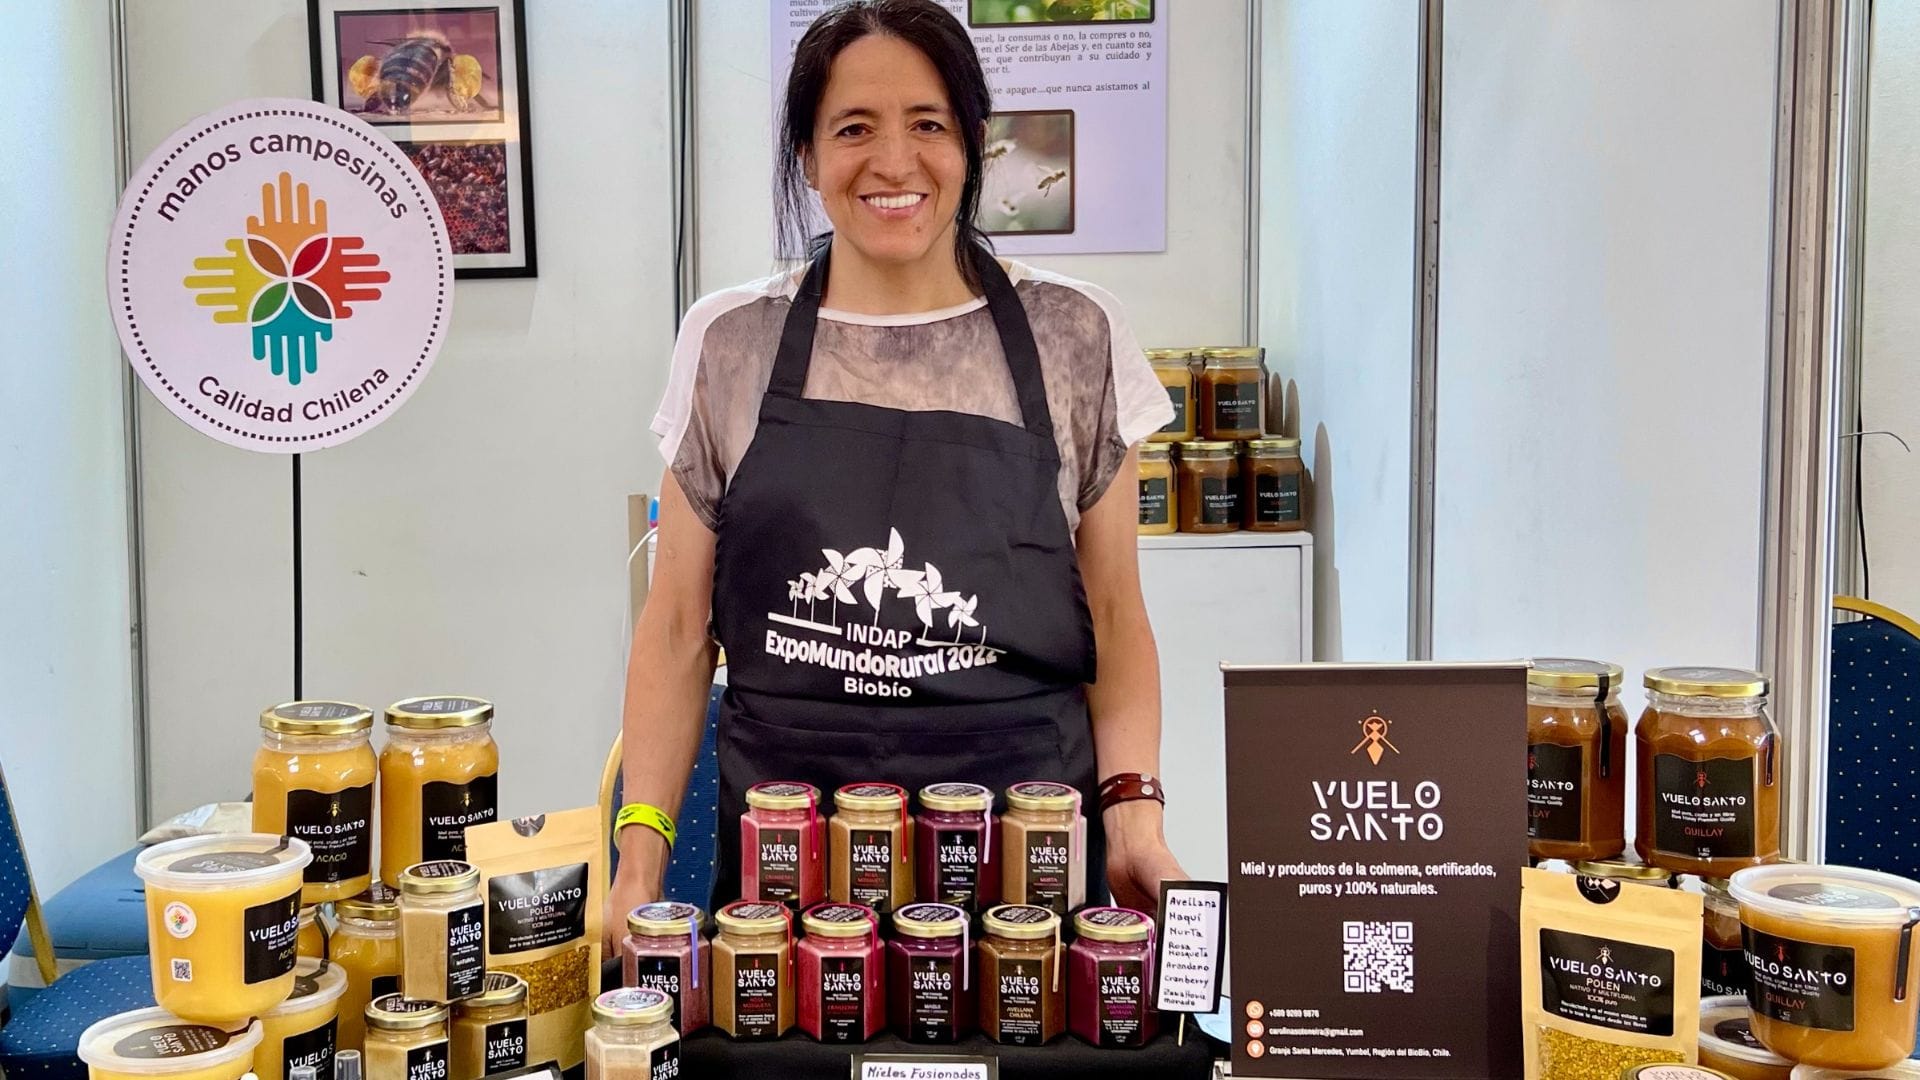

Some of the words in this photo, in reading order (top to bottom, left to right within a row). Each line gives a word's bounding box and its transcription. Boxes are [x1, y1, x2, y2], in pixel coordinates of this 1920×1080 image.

[997, 33, 1005, 42] la
[1079, 32, 1087, 40] la
[1090, 32, 1127, 42] compres
[1005, 44, 1019, 52] Ser
[1022, 44, 1032, 52] de
[1036, 43, 1047, 51] las
[1050, 43, 1079, 53] Abejas
[1105, 42, 1134, 50] cuanto
[1137, 41, 1151, 49] sea
[996, 56, 1013, 65] que
[1019, 53, 1071, 64] contribuyan
[1089, 53, 1099, 61] su
[1106, 51, 1140, 60] cuidado
[1066, 84, 1092, 92] nunca
[1096, 82, 1138, 91] asistamos
[1142, 81, 1150, 90] al
[157, 142, 242, 223] manos
[249, 134, 408, 219] campesinas
[198, 375, 293, 422] Calidad
[302, 368, 389, 421] Chilena
[847, 622, 912, 649] INDAP
[765, 629, 945, 679] ExpoMundoRural
[949, 645, 997, 672] 2022
[844, 677, 912, 698] Biobío
[1531, 779, 1574, 791] SANTO
[1312, 780, 1441, 809] VUELO
[1662, 792, 1700, 806] VUELO
[1703, 795, 1746, 806] SANTO
[429, 815, 466, 826] VUELO
[467, 807, 494, 823] SANTO
[294, 825, 333, 834] VUELO
[334, 819, 366, 834] SANTO
[1310, 813, 1444, 841] SANTO
[1684, 826, 1724, 837] QUILLAY
[762, 844, 797, 853] VUELO
[853, 844, 889, 854] VUELO
[941, 845, 976, 855] VUELO
[1030, 846, 1067, 856] VUELO
[315, 852, 348, 863] ACACIO
[761, 852, 797, 862] SANTO
[853, 853, 890, 863] SANTO
[940, 853, 977, 863] SANTO
[1030, 855, 1067, 864] SANTO
[1241, 861, 1265, 875] Miel
[1268, 865, 1275, 878] y
[1278, 862, 1335, 878] productos
[1338, 862, 1353, 875] de
[1356, 862, 1367, 875] la
[1369, 862, 1422, 877] colmena,
[1425, 862, 1496, 877] certificados,
[1299, 884, 1332, 897] puros
[1335, 884, 1342, 897] y
[1345, 881, 1378, 895] 100%
[1381, 881, 1438, 895] naturales.
[498, 895, 540, 912] VUELO
[542, 887, 581, 904] SANTO
[1169, 896, 1217, 908] Avellana
[529, 905, 555, 917] POLEN
[250, 920, 291, 942] VUELO
[450, 922, 481, 936] VUELO
[450, 930, 482, 946] SANTO
[1549, 956, 1601, 977] VUELO
[1604, 967, 1661, 987] SANTO
[1744, 949, 1780, 975] VUELO
[1782, 965, 1847, 985] SANTO
[642, 974, 678, 984] VUELO
[738, 969, 775, 978] VUELO
[824, 973, 861, 982] VUELO
[914, 971, 951, 981] VUELO
[737, 978, 776, 987] SANTO
[913, 980, 951, 990] SANTO
[1001, 975, 1039, 985] VUELO
[1101, 976, 1140, 986] VUELO
[1586, 977, 1620, 992] POLEN
[1701, 977, 1723, 993] UELO
[823, 982, 861, 991] SANTO
[1000, 984, 1039, 995] SANTO
[1101, 985, 1140, 994] SANTO
[1765, 992, 1806, 1010] QUILLAY
[488, 1036, 523, 1049] VUELO
[488, 1045, 523, 1059] SANTO
[1292, 1046, 1310, 1055] Santa
[289, 1048, 328, 1069] VUELO
[411, 1059, 445, 1075] VUELO
[653, 1057, 678, 1075] VUELO
